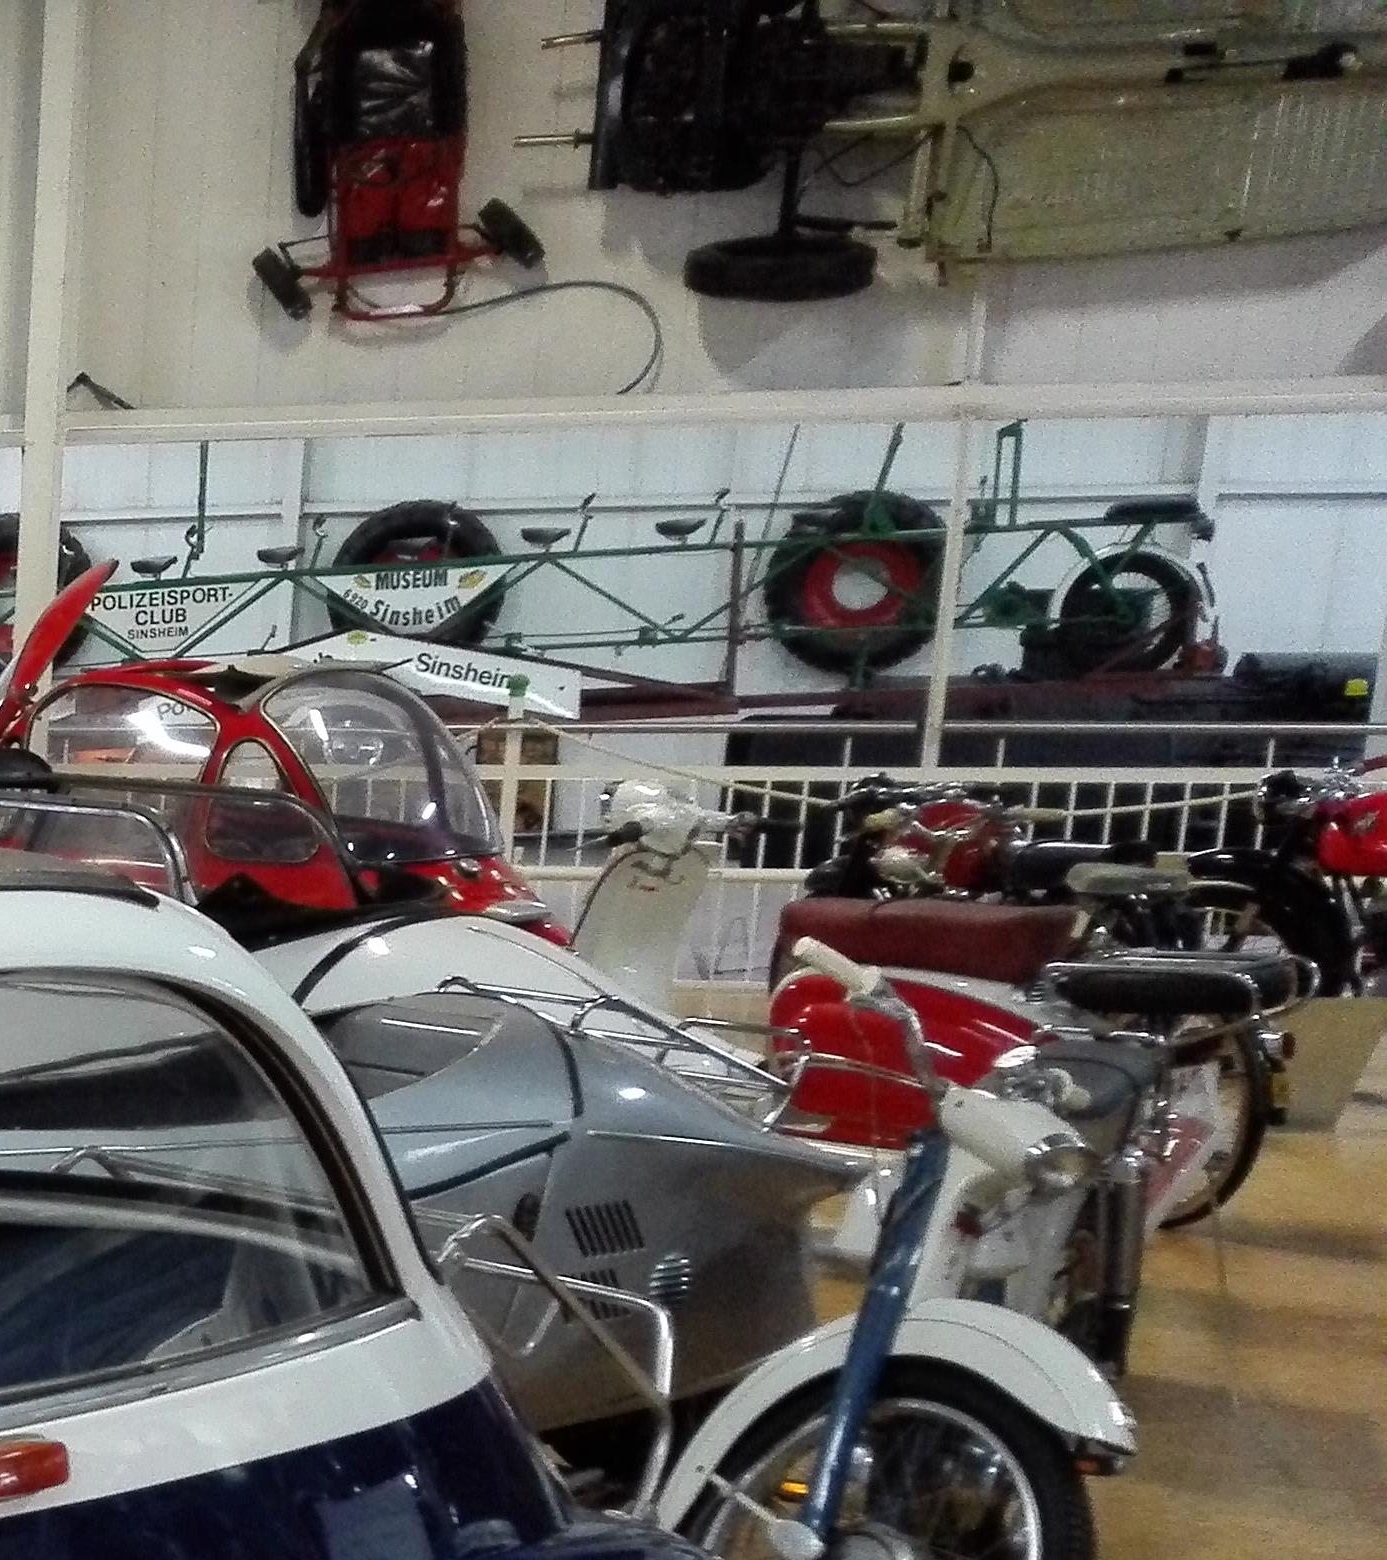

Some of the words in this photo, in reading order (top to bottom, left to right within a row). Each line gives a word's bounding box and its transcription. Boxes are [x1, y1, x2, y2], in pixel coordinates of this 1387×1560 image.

[375, 567, 449, 591] MUSEUM
[91, 586, 233, 611] POLIZEISPORT-
[369, 595, 462, 626] Sinsheim
[135, 608, 187, 626] CLUB
[127, 626, 189, 640] SINSHEIM
